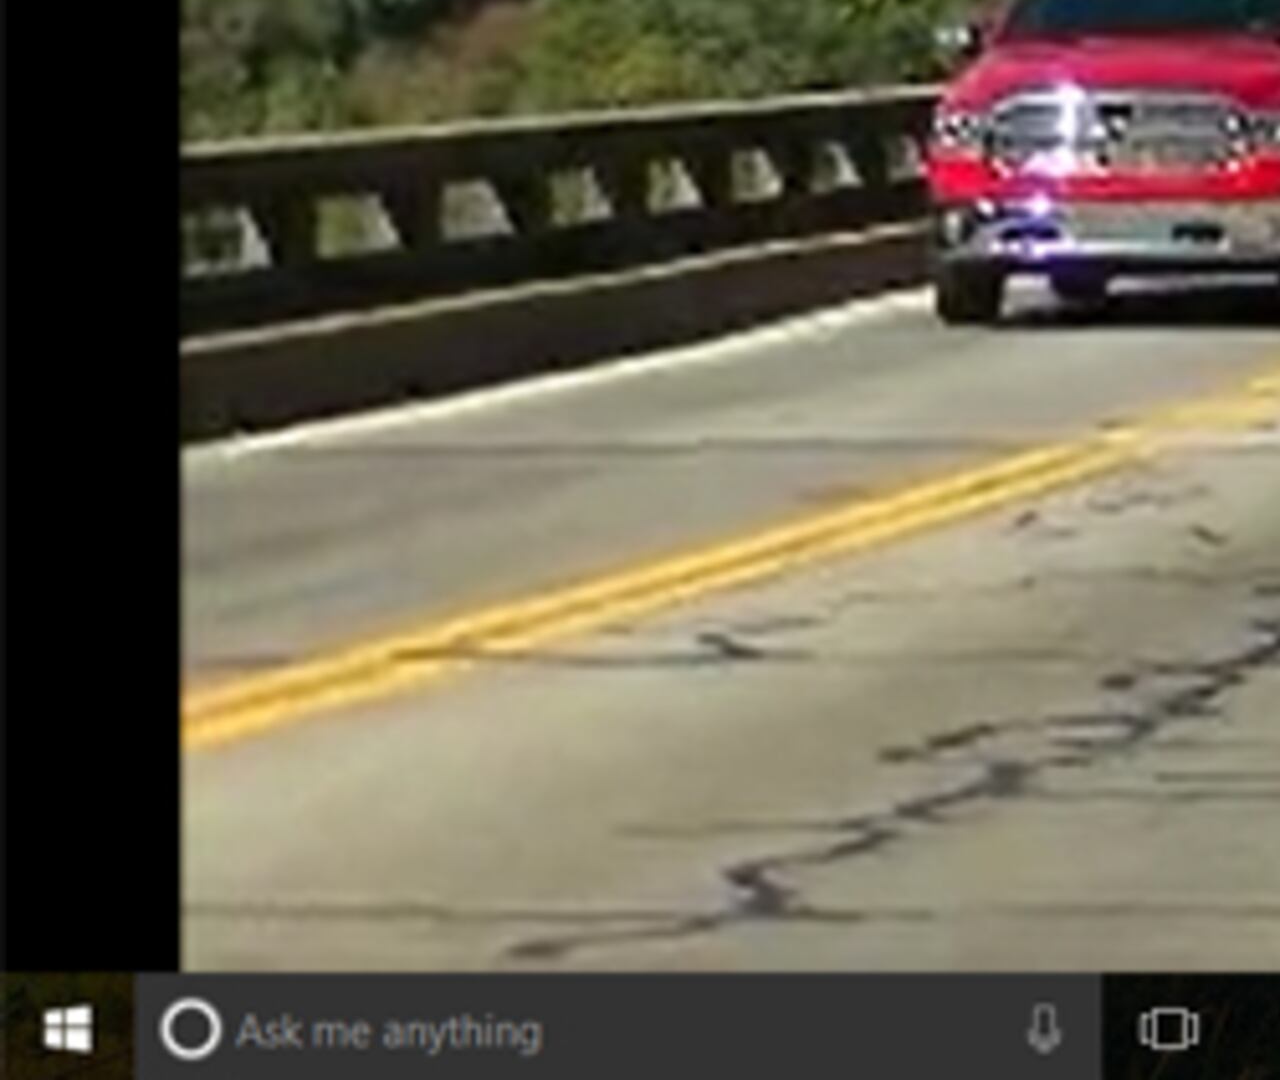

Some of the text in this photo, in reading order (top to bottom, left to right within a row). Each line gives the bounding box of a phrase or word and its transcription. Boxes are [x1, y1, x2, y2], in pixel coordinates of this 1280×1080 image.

[235, 1012, 545, 1057] Ask me anything
